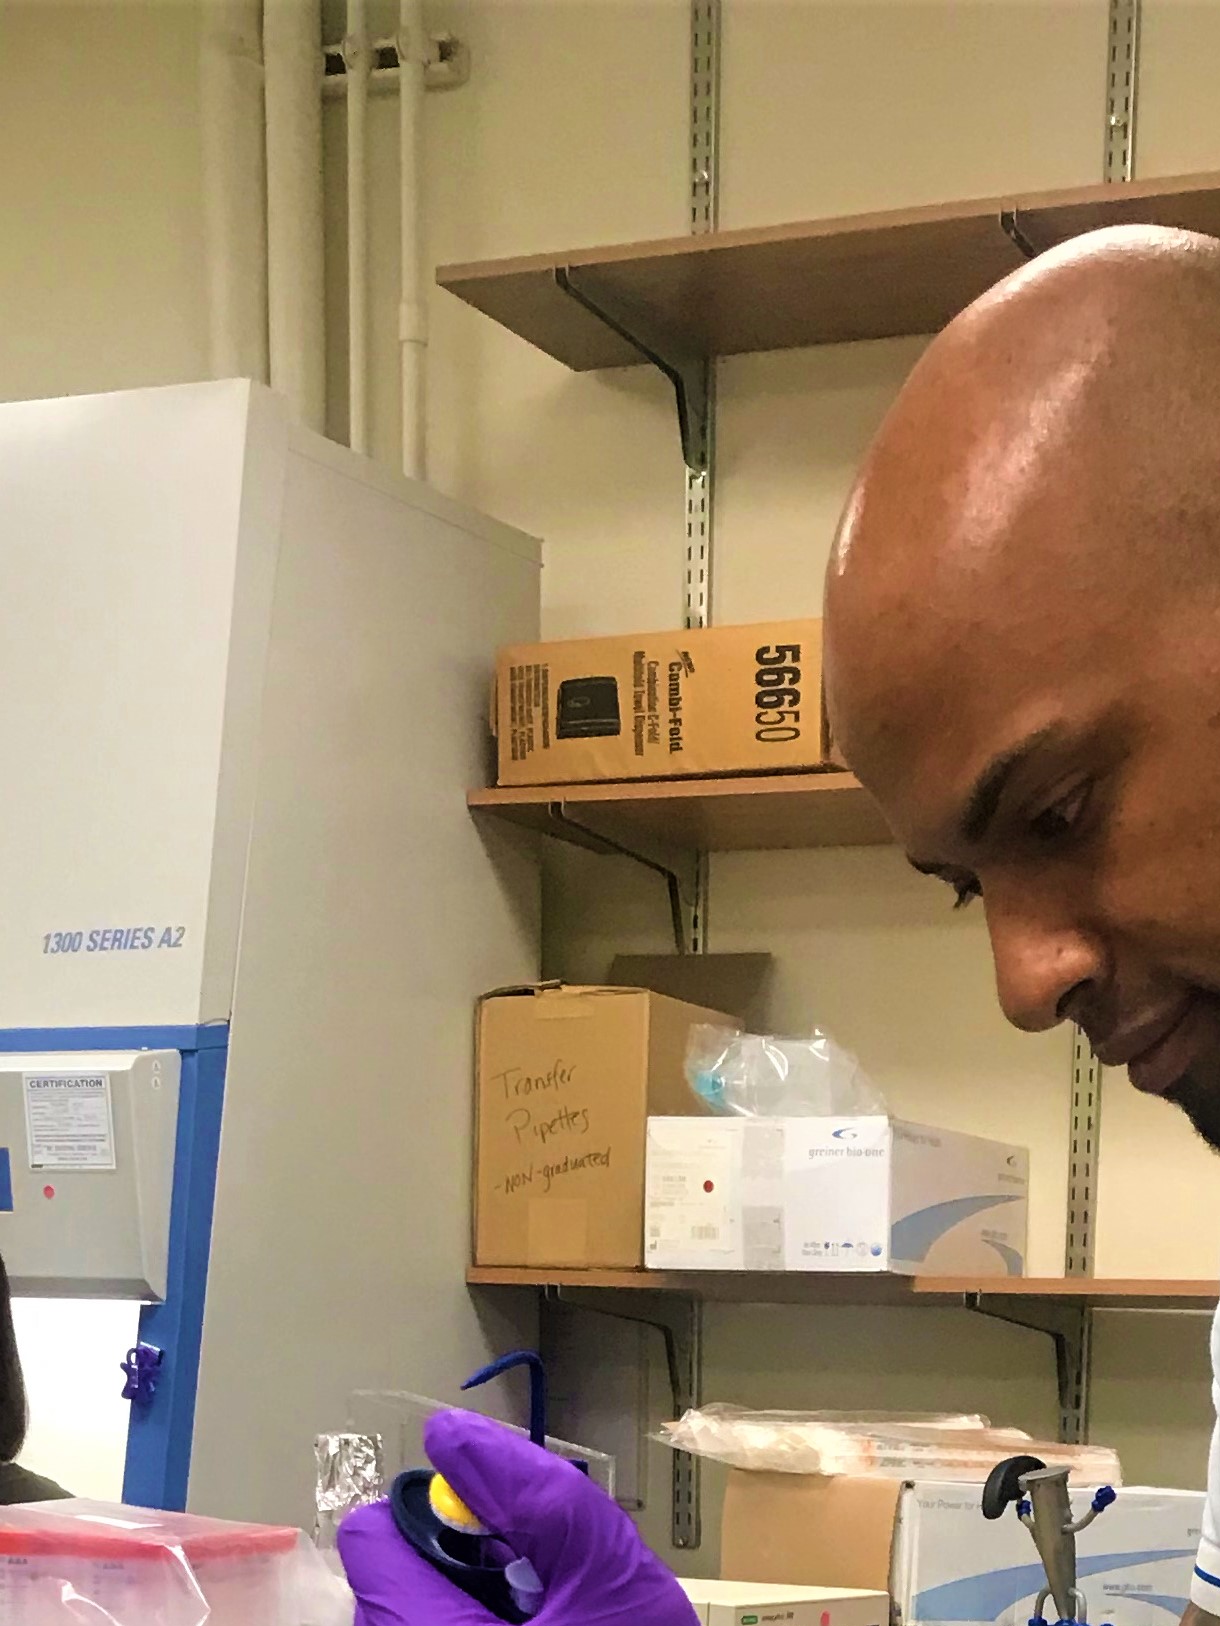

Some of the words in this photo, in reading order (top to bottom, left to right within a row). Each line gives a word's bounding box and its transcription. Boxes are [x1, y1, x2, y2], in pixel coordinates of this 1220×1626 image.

[755, 644, 802, 742] 56650
[43, 932, 83, 954] 1300
[87, 926, 156, 952] SERIES
[157, 925, 186, 949] A2
[29, 1079, 103, 1089] CERTIFICATION
[490, 1058, 577, 1099] Transfer
